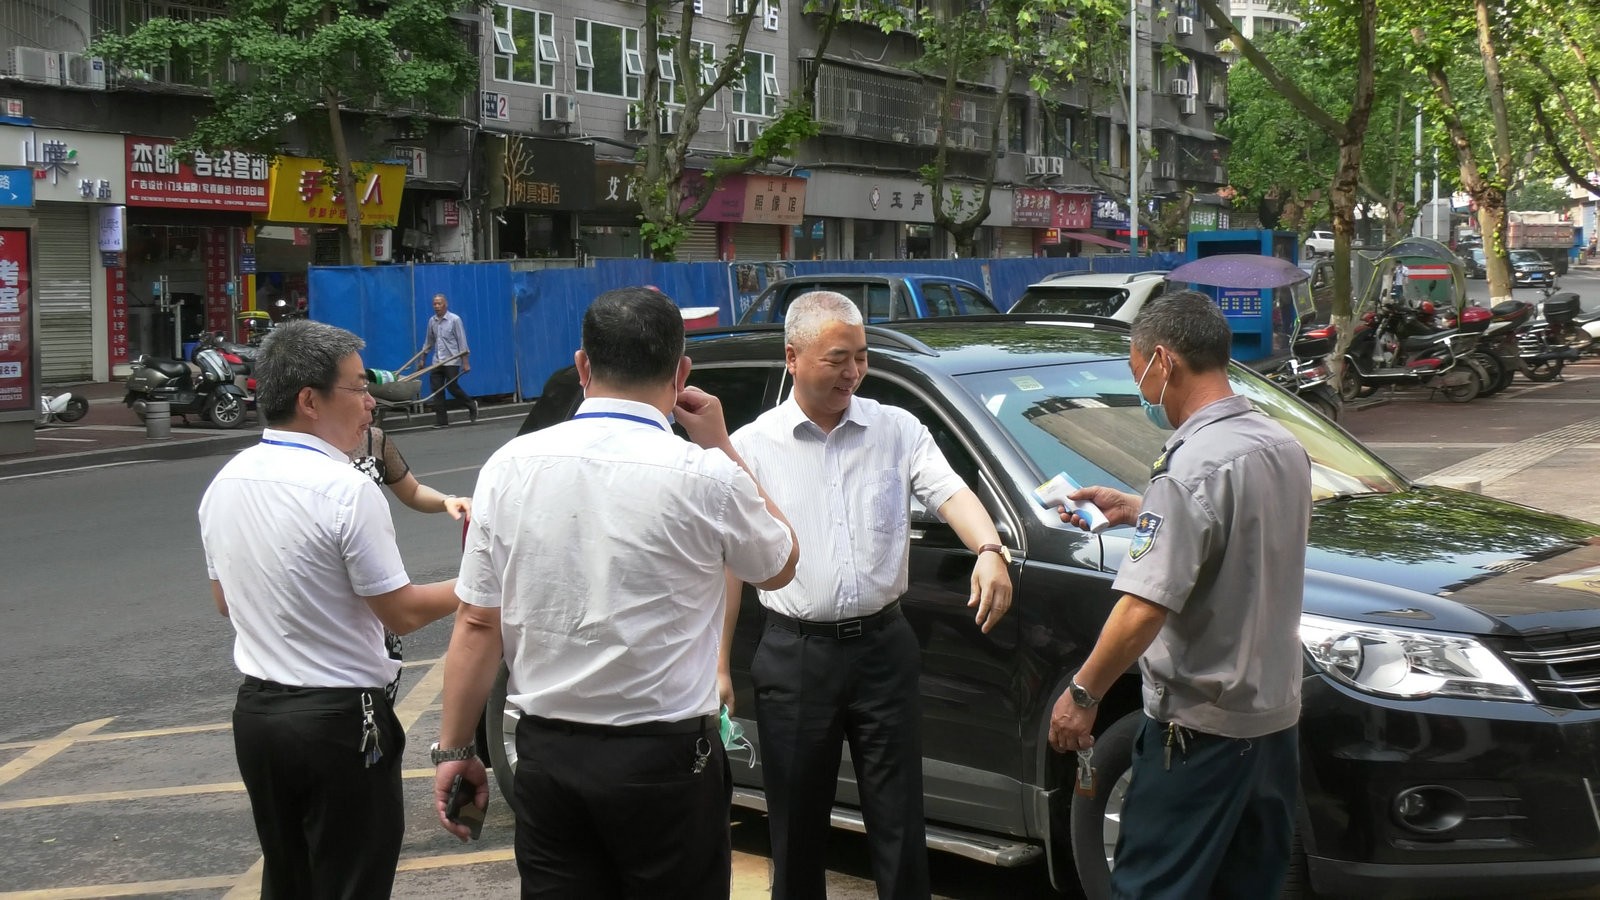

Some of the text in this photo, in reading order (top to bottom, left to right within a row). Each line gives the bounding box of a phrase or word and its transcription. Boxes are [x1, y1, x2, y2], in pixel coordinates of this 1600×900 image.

[499, 97, 507, 117] 2
[131, 143, 268, 180] 杰创告经营部
[78, 179, 112, 200] 饮品
